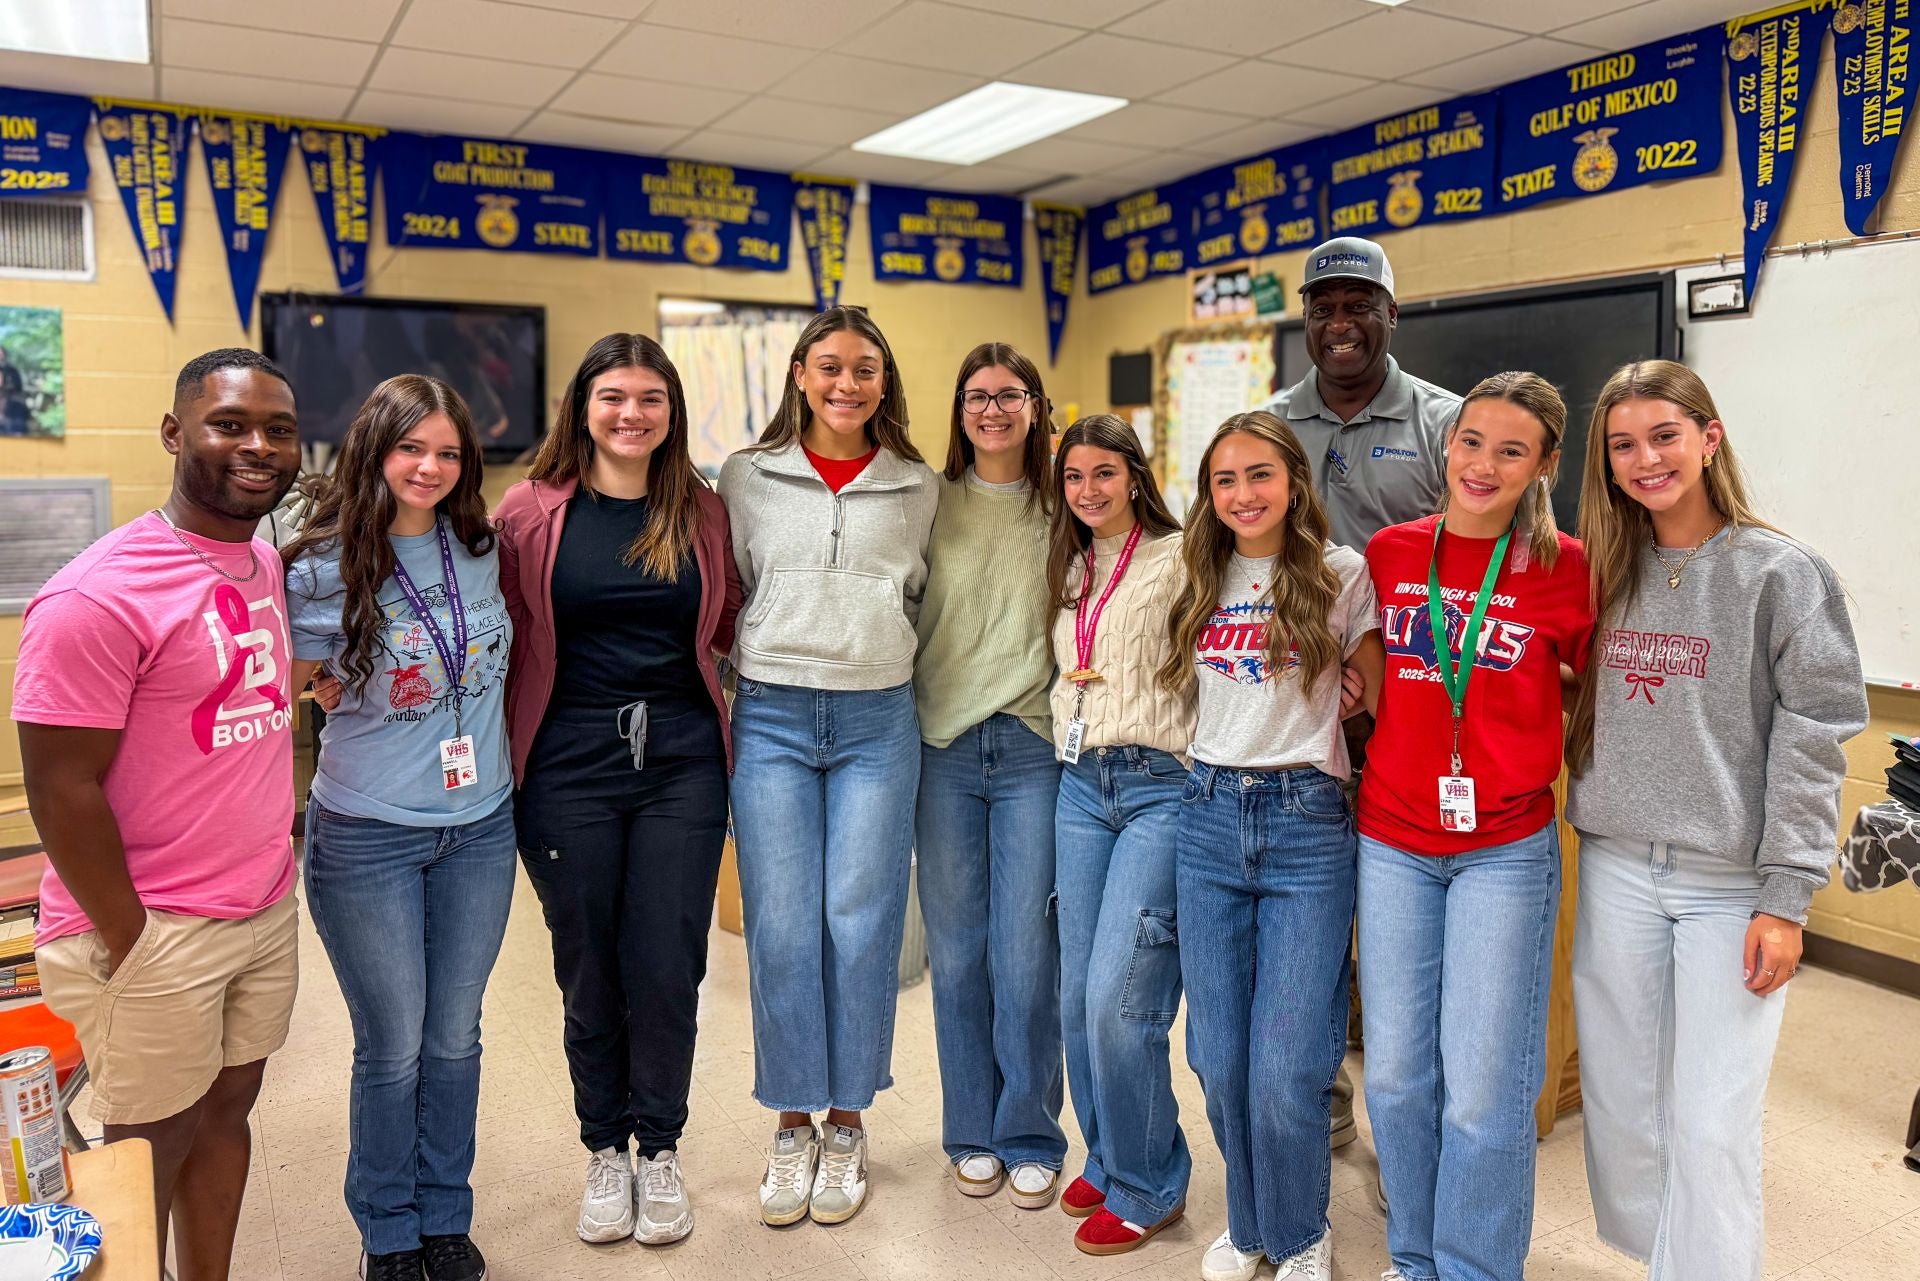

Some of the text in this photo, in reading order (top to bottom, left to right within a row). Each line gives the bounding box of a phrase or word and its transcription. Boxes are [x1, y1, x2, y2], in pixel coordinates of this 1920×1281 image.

[1567, 53, 1636, 93] THIRD
[1843, 54, 1862, 96] 22-23
[1863, 0, 1885, 146] EMPLOYMENT SKILLS
[1885, 25, 1910, 105] AREA
[1739, 73, 1756, 114] 22-23
[1778, 16, 1800, 153] 2ND AREA III
[1529, 78, 1678, 138] GULF OF MEXICO
[1757, 21, 1778, 188] EXTEMPORANEOUS SPEAKING
[0, 114, 37, 140] ION
[1375, 106, 1439, 144] FOURTH
[1882, 106, 1903, 138] III
[463, 141, 528, 167] FIRST
[1426, 124, 1484, 159] SPEAKING
[1636, 139, 1697, 174] 2022
[0, 168, 70, 190] 2025
[152, 140, 173, 199] AREA
[249, 147, 267, 205] AREA
[471, 165, 555, 191] PRODUCTION
[1501, 164, 1557, 202] STATE
[1855, 164, 1864, 200] Coleman
[1864, 163, 1872, 197] Demond
[348, 161, 367, 217] AREA
[1433, 187, 1483, 215] 2022
[403, 212, 460, 239] 2024
[1332, 200, 1379, 232] STATE
[533, 222, 592, 249] STATE
[616, 228, 674, 255] STATE
[881, 251, 926, 274] STATE
[1331, 253, 1368, 263] BOLTON
[1386, 448, 1418, 457] BOLTON
[1466, 590, 1517, 609] SCOOL
[467, 616, 495, 635] PLACE
[1382, 606, 1535, 663] LINS
[1598, 629, 1711, 679] SENIOR
[1607, 643, 1689, 662] class of 2026
[1398, 667, 1458, 684] 2025-20
[446, 743, 469, 757] VHS
[1445, 784, 1469, 797] VHS
